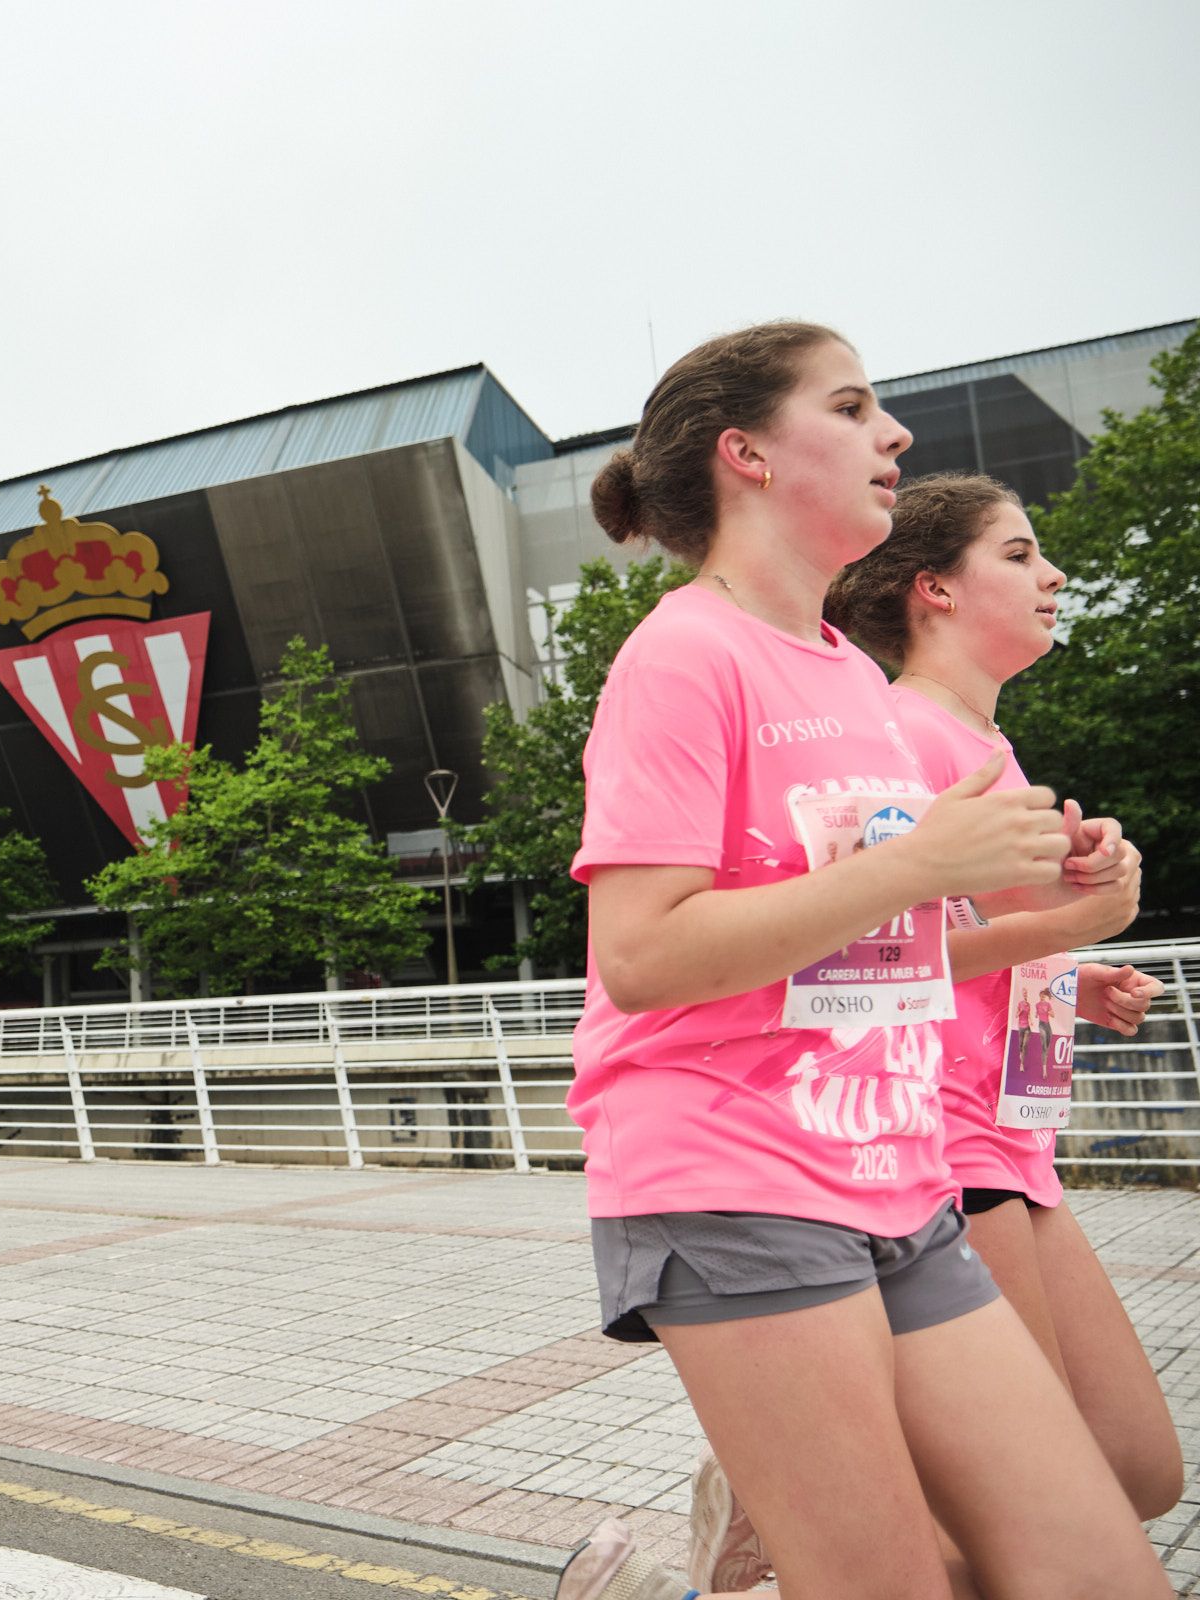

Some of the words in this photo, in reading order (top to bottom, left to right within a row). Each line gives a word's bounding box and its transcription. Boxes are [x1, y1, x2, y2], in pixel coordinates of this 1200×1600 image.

[757, 716, 843, 747] OYSHO
[878, 946, 901, 962] 129
[817, 967, 860, 981] CARRERA
[862, 967, 875, 980] DE
[877, 967, 888, 980] LA
[1020, 967, 1047, 980] SUMA
[811, 996, 874, 1014] OYSHO
[851, 1144, 898, 1181] 2026
